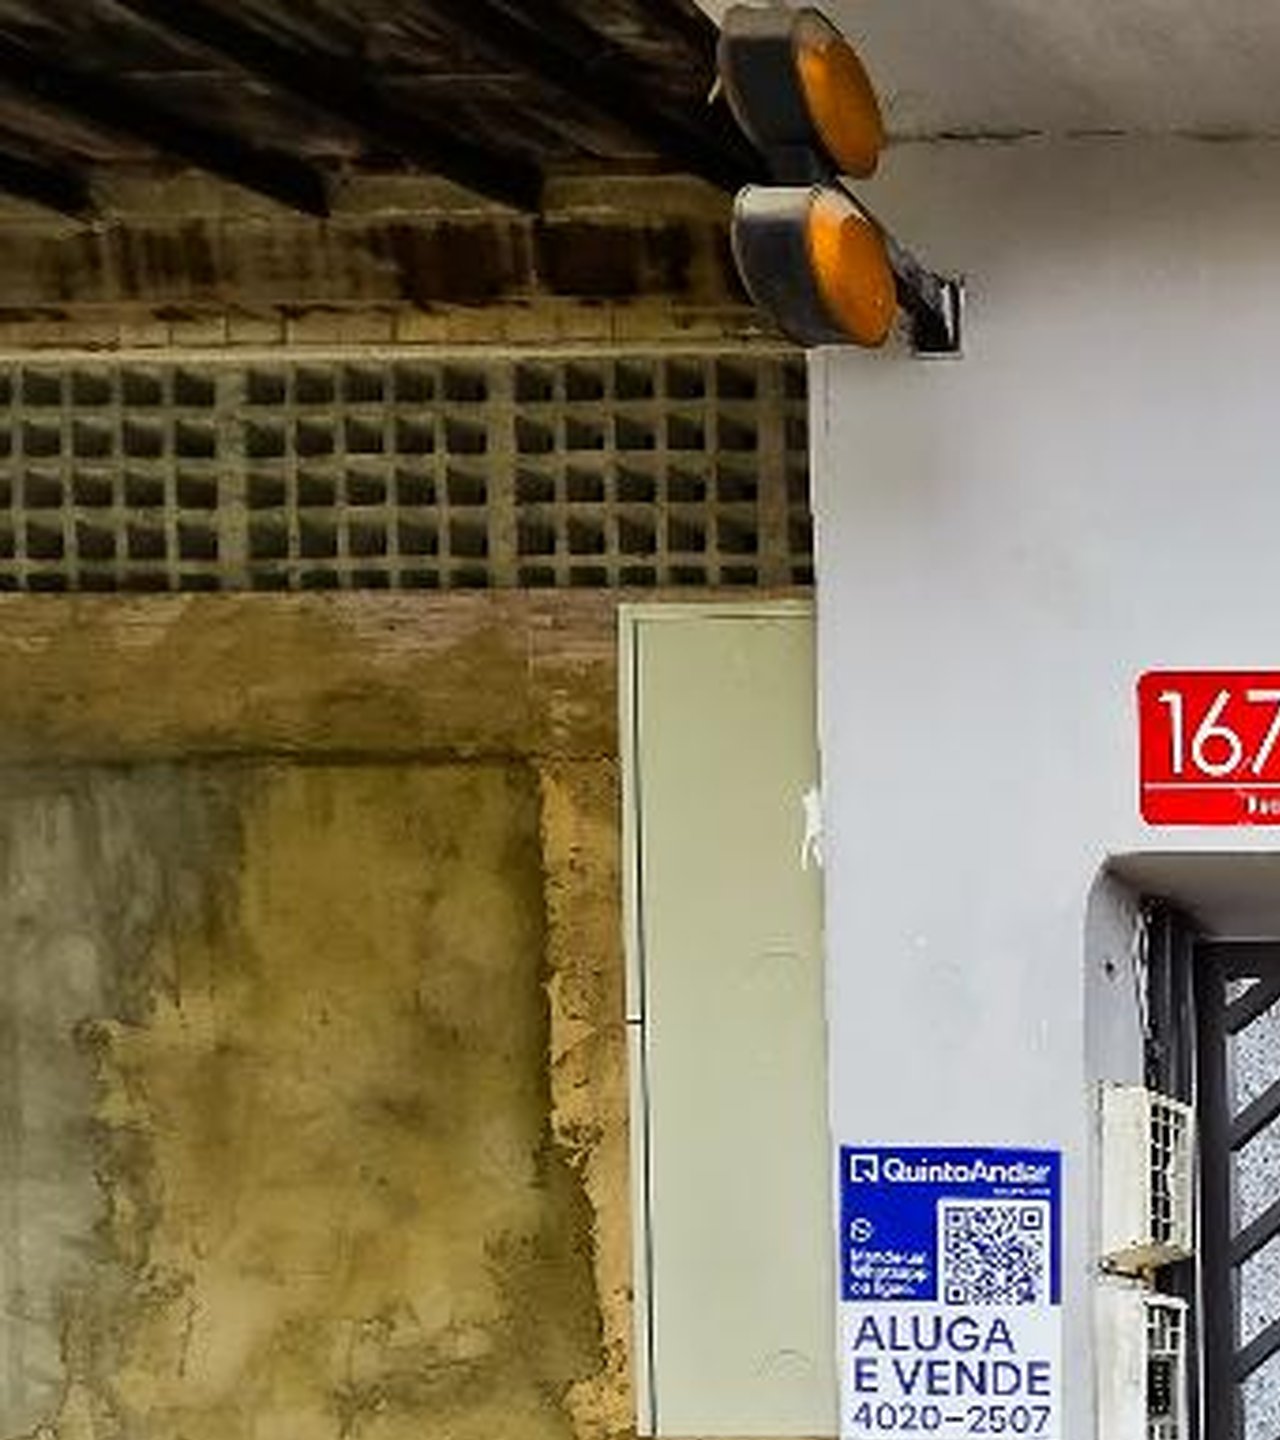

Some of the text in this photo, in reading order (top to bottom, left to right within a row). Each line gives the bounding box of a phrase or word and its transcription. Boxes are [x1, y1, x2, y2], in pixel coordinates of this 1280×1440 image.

[883, 1158, 1051, 1183] QuintoAndar
[852, 1315, 1016, 1353] ALUGA
[854, 1357, 1051, 1396] E VENDE
[852, 1401, 1051, 1433] 4020-2507
